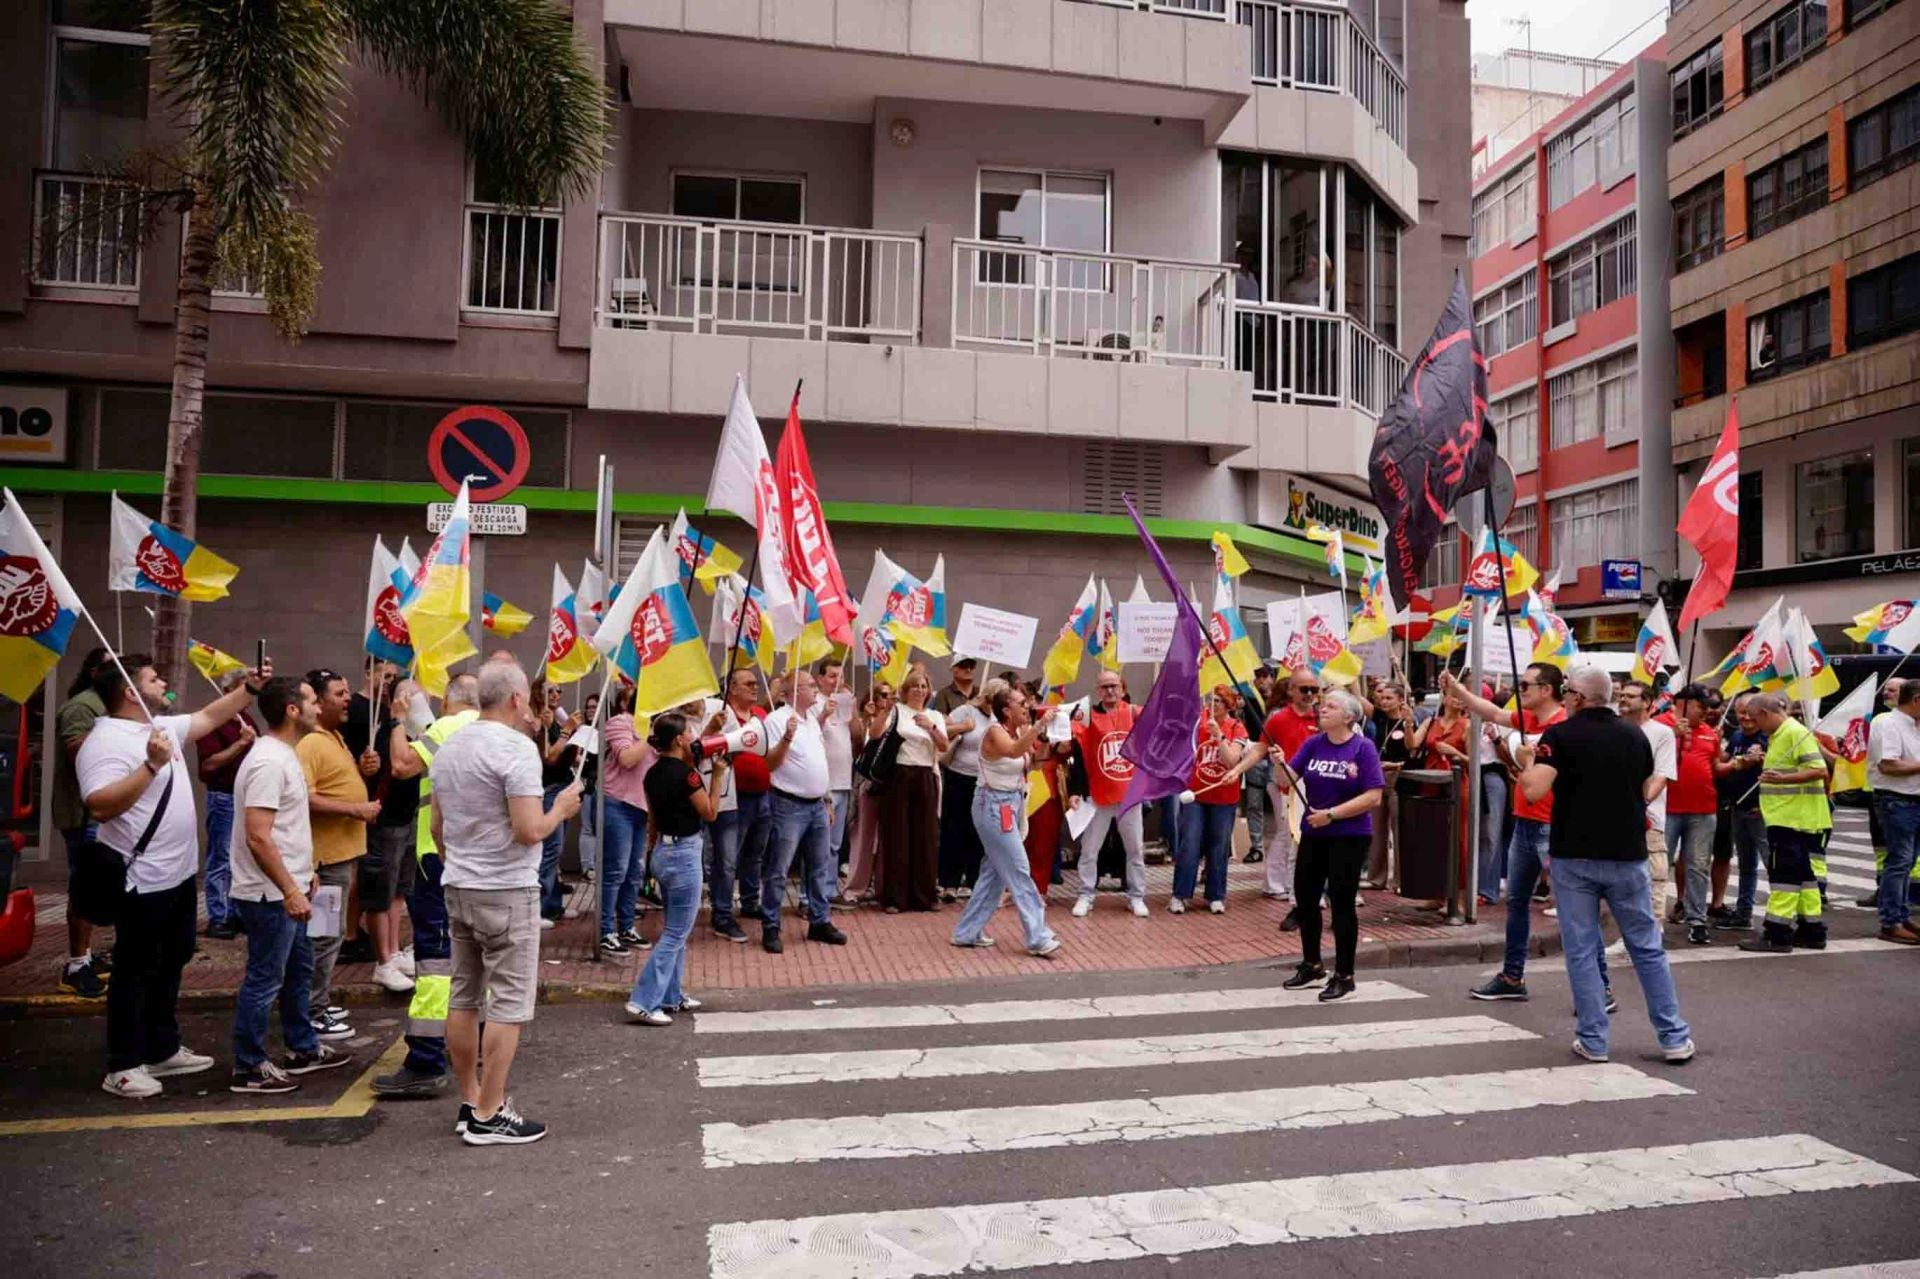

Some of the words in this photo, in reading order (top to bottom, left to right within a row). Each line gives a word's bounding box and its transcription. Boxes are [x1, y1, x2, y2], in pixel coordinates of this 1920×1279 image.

[477, 506, 516, 514] FESTIVOS
[1305, 491, 1378, 539] SuperDino
[474, 515, 517, 523] DESCARGA
[1308, 759, 1338, 772] UGT
